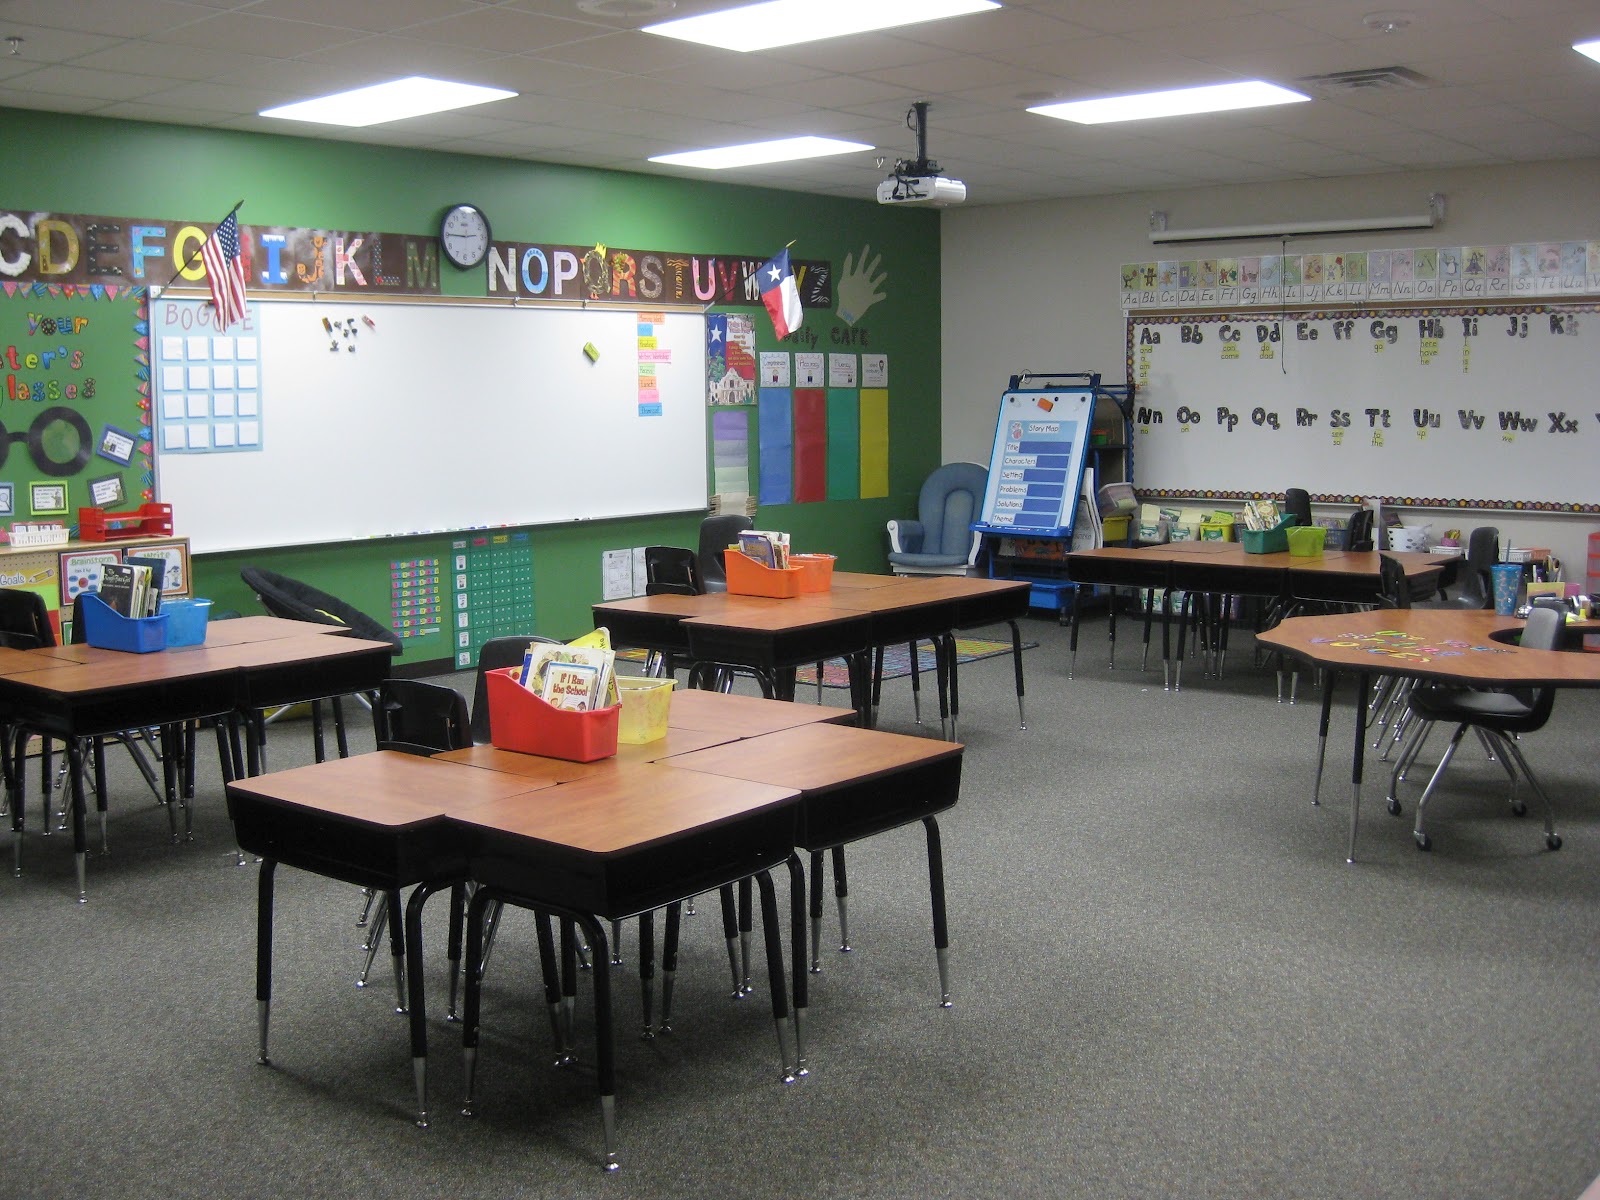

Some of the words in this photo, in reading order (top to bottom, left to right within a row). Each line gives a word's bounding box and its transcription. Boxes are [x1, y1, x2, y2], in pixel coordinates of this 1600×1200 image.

[39, 220, 79, 275] D
[87, 223, 122, 276] E
[131, 226, 166, 278] F
[261, 234, 289, 284] I
[296, 236, 328, 285] J
[335, 237, 368, 286] K
[374, 237, 400, 286] L
[406, 241, 437, 288] M
[488, 246, 517, 292] N
[522, 248, 549, 294] O
[553, 251, 579, 295] P
[612, 253, 637, 297] R
[639, 255, 665, 299] S
[667, 257, 689, 299] T
[692, 257, 716, 301] U
[717, 260, 740, 301] V
[810, 265, 829, 303] Z
[1124, 294, 1137, 304] Aa
[1142, 293, 1155, 302] Bb
[1161, 292, 1175, 301] Cc
[1180, 291, 1195, 301] Dd
[1201, 291, 1214, 301] Ee
[1221, 290, 1234, 300] Ff
[1242, 288, 1256, 303] Gg
[1262, 287, 1278, 298] Hh
[1286, 286, 1296, 297] Ii
[1306, 285, 1319, 301] Jj
[1326, 284, 1343, 296] Kk
[1350, 284, 1362, 295] Ll
[1369, 283, 1390, 294] Mm
[1393, 283, 1411, 294] Nn
[1417, 281, 1432, 293] Oo
[1443, 280, 1457, 296] Pp
[1464, 279, 1482, 296] Qq
[1489, 278, 1506, 291] Rr
[1516, 278, 1531, 290] Ss
[1541, 276, 1556, 289] Tt
[1563, 275, 1583, 288] Uu
[1140, 327, 1161, 345] Aa
[1180, 324, 1203, 344] Bb
[1219, 325, 1241, 343] Cc
[1256, 322, 1281, 343] Dd
[1296, 322, 1319, 341] Ee
[1332, 320, 1355, 341] Ff
[1370, 320, 1398, 345] Gg
[1418, 319, 1444, 339] Hh
[1462, 318, 1478, 337] Ii
[1506, 315, 1528, 338] Jj
[1550, 314, 1579, 337] Kk
[0, 374, 96, 408] lasses
[1137, 406, 1163, 424] Nn
[1176, 406, 1201, 424] Oo
[1217, 406, 1239, 432] Pp
[1251, 407, 1280, 430] Qq
[1295, 407, 1318, 427] Rr
[1329, 409, 1351, 428] Ss
[1364, 408, 1391, 428] Tt
[1412, 408, 1441, 428] Uu
[1457, 409, 1485, 430] Vv
[1498, 411, 1538, 432] Ww
[1547, 411, 1579, 434] Xx
[1028, 423, 1044, 434] Story
[1046, 423, 1059, 433] Map
[1007, 443, 1019, 452] Title
[1004, 457, 1037, 465] Characters
[1002, 471, 1024, 480] Setting
[1000, 486, 1027, 494] Problems
[997, 500, 1023, 508] Solutions
[993, 514, 1013, 523] Theme
[70, 556, 114, 566] Brainstorm
[0, 573, 25, 587] Goals
[561, 673, 567, 683] If
[568, 674, 572, 683] I
[572, 674, 585, 685] Ran
[553, 683, 565, 694] the
[566, 686, 588, 697] School
